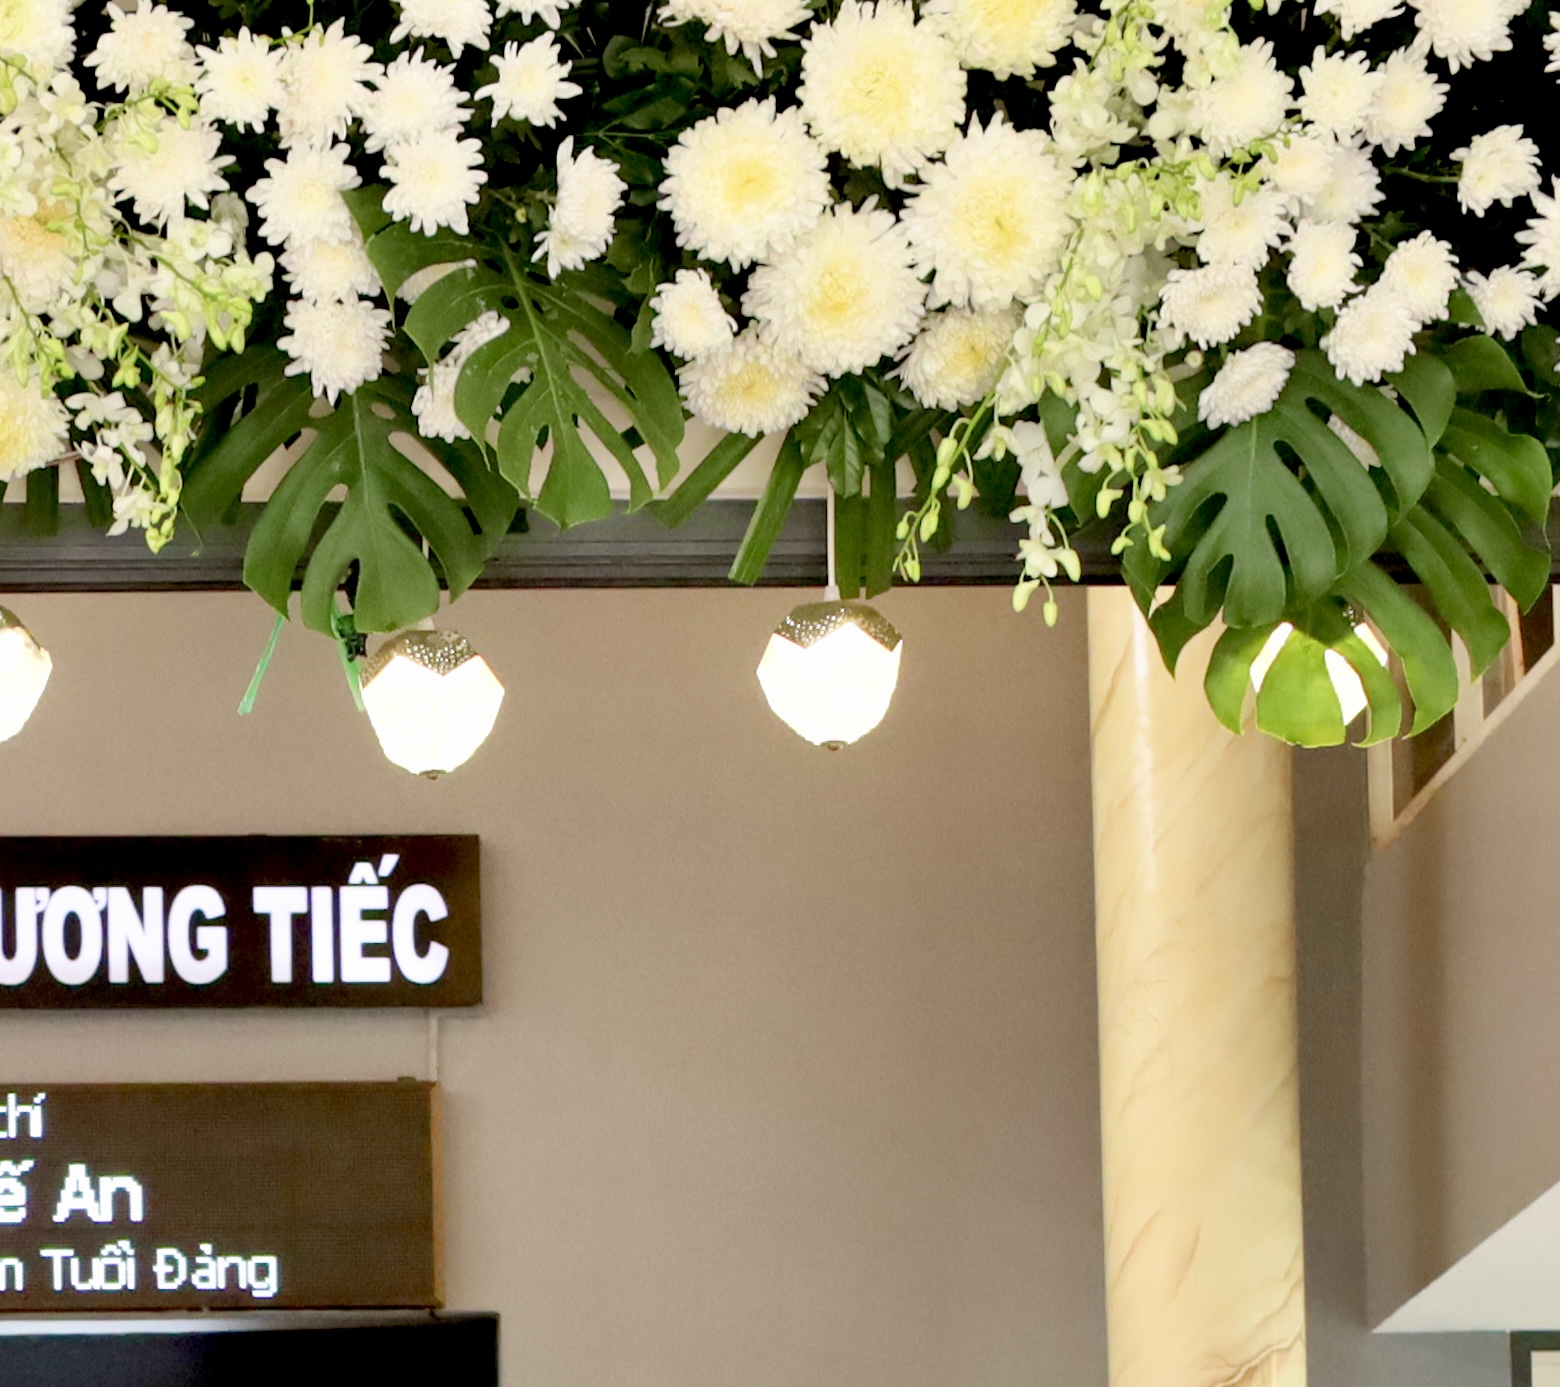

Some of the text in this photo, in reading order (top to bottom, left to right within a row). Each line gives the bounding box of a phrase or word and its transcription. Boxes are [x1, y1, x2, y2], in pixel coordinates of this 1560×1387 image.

[252, 854, 449, 984] TIẾC
[51, 1163, 144, 1223] An
[39, 1239, 136, 1291] Tuổi
[152, 1242, 278, 1298] Đảng
